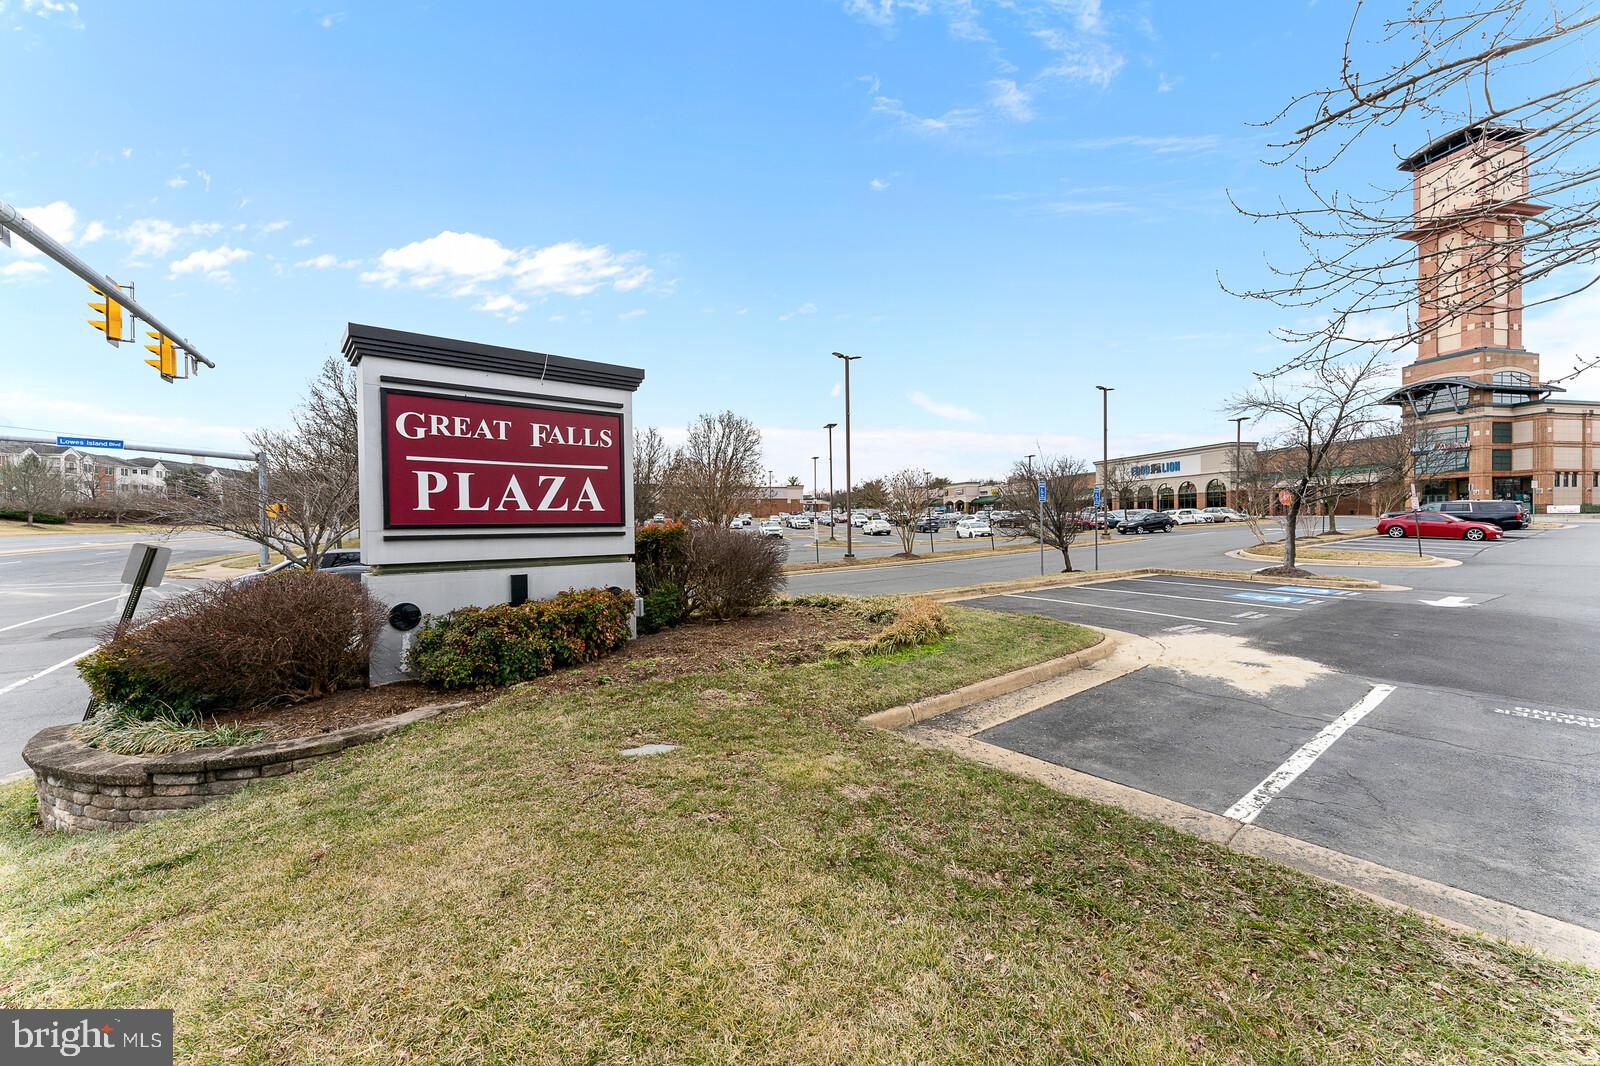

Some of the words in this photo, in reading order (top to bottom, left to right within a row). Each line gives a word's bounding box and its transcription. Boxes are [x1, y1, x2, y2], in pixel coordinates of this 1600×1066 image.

[395, 411, 512, 440] GREAT
[529, 422, 613, 448] FALLS
[1161, 460, 1181, 473] LION
[411, 470, 606, 512] PLAZA
[1514, 706, 1600, 722] RKING
